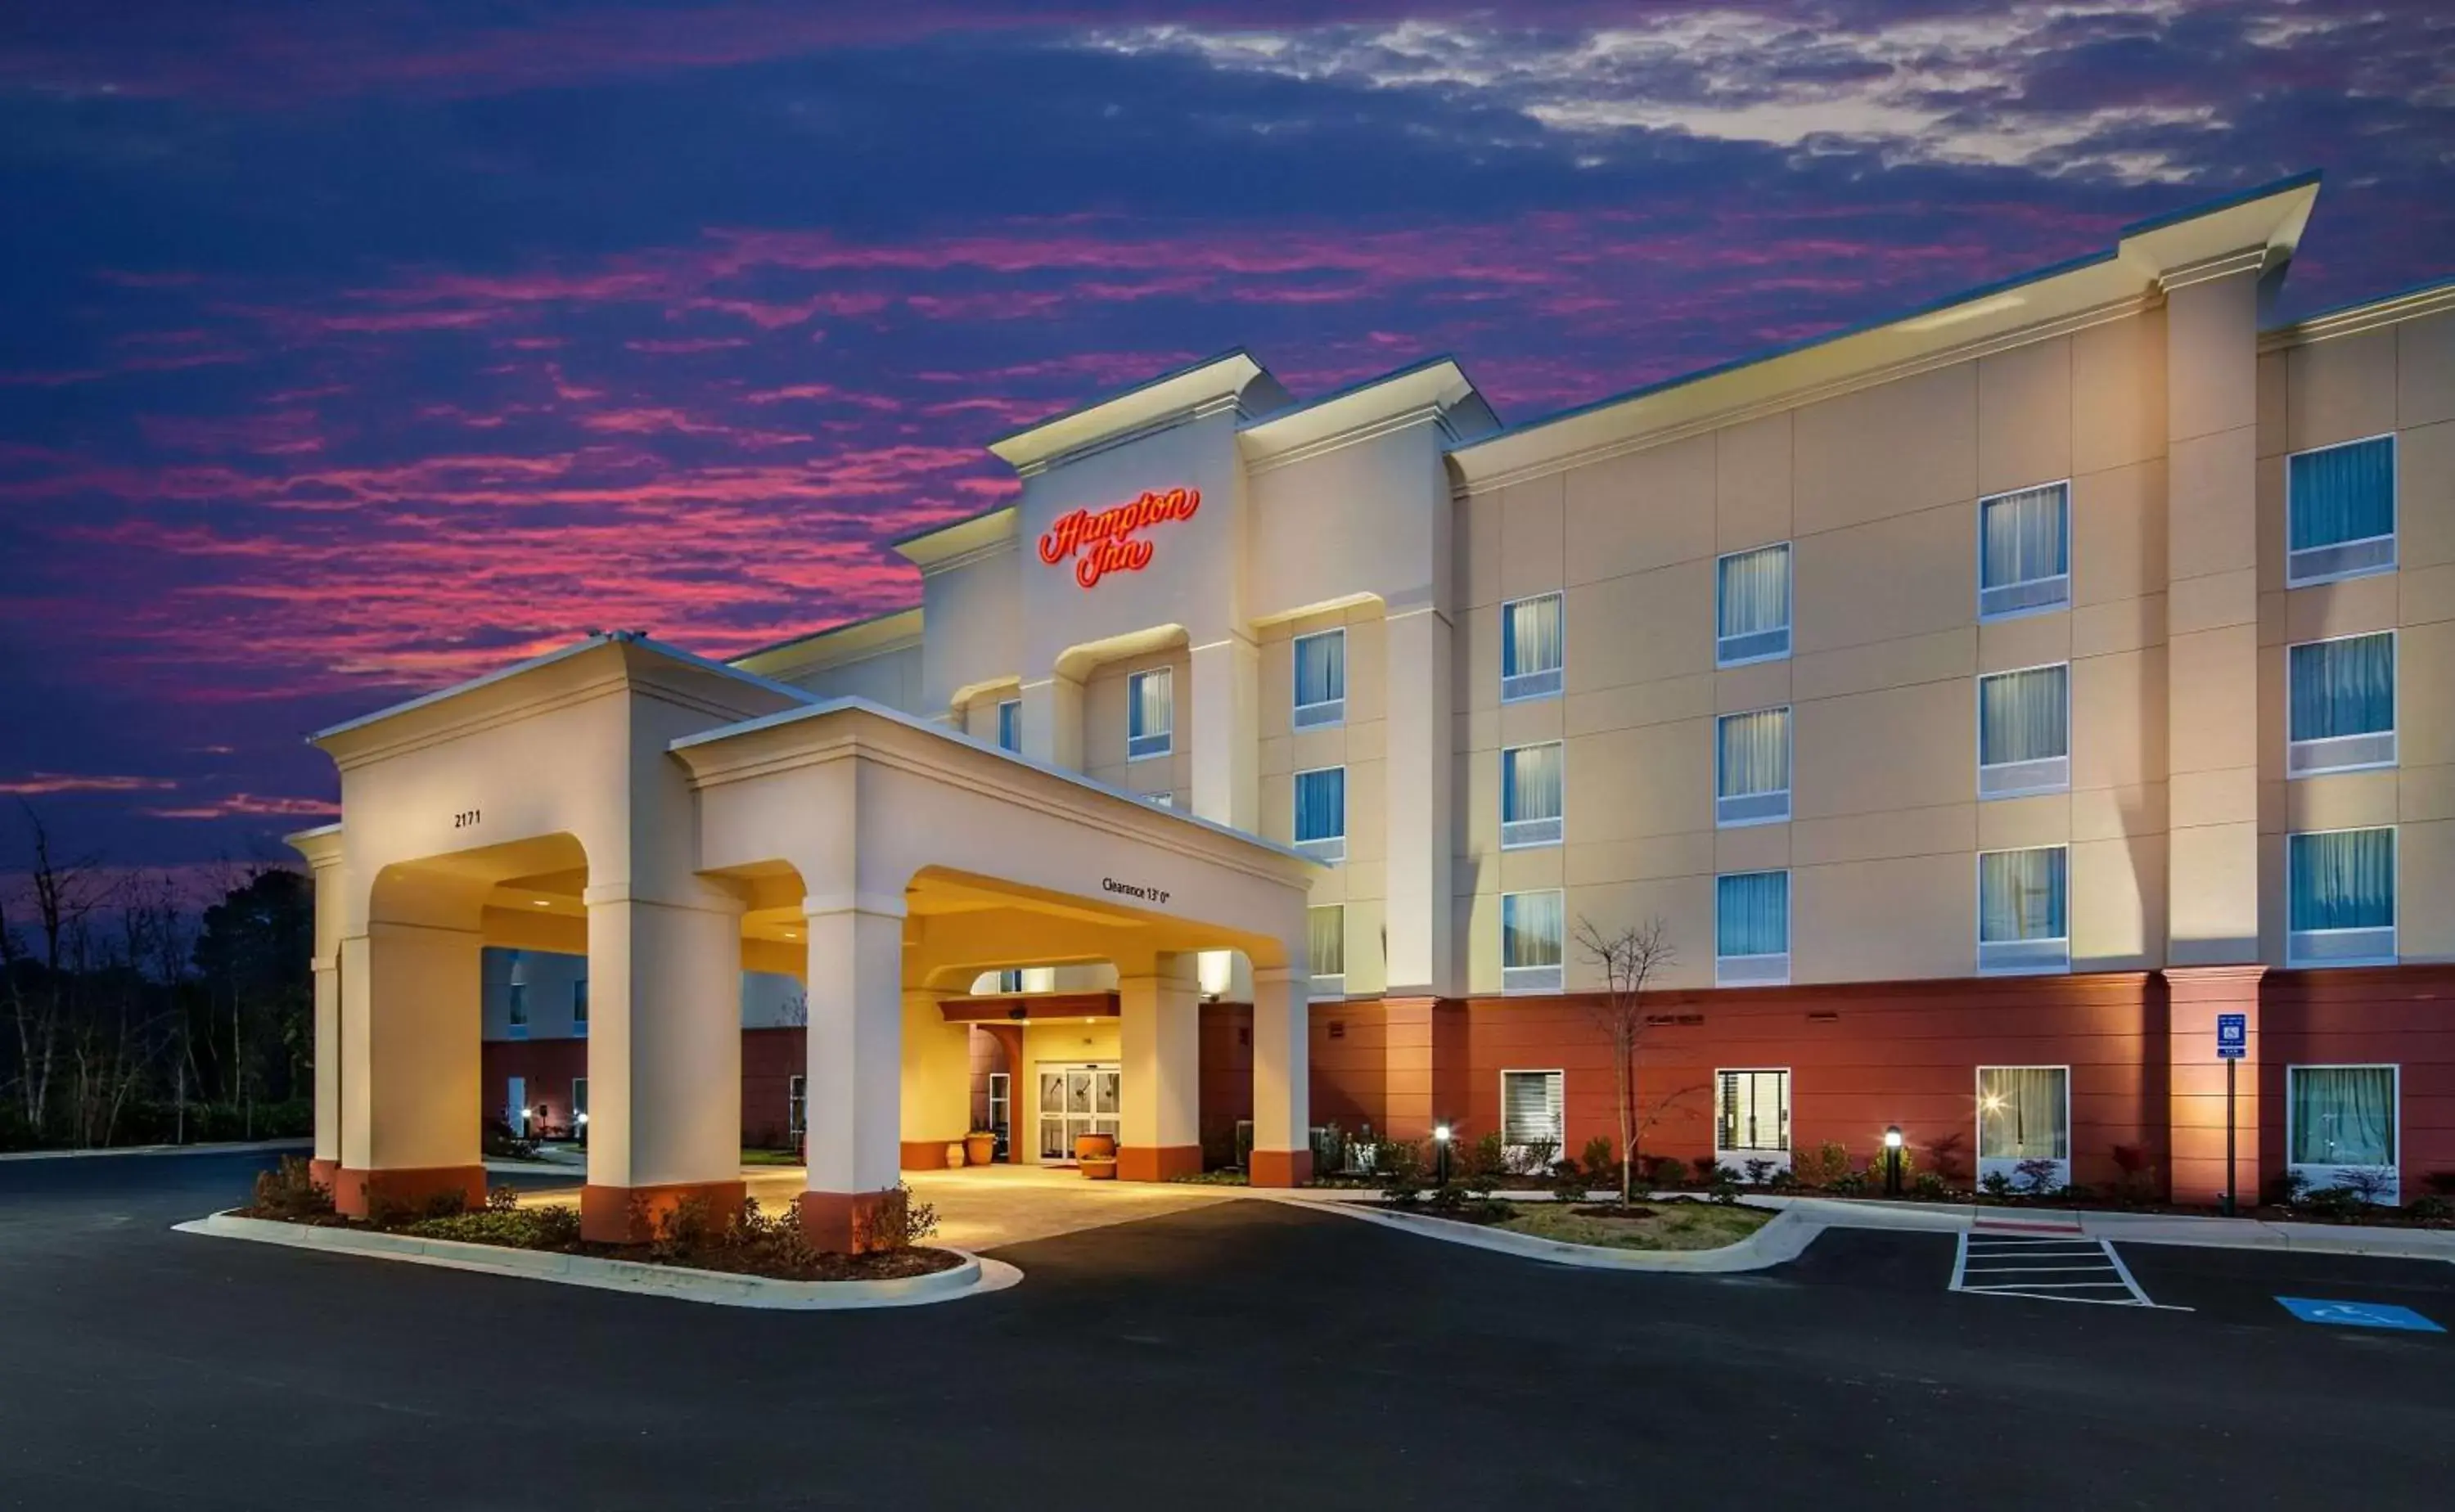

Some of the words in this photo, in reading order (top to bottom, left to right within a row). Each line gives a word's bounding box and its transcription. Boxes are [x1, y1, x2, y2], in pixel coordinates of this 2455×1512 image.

[1039, 488, 1200, 564] Hampton
[1076, 541, 1153, 588] Inn
[454, 809, 480, 828] 2171
[1101, 877, 1145, 898] Clearance
